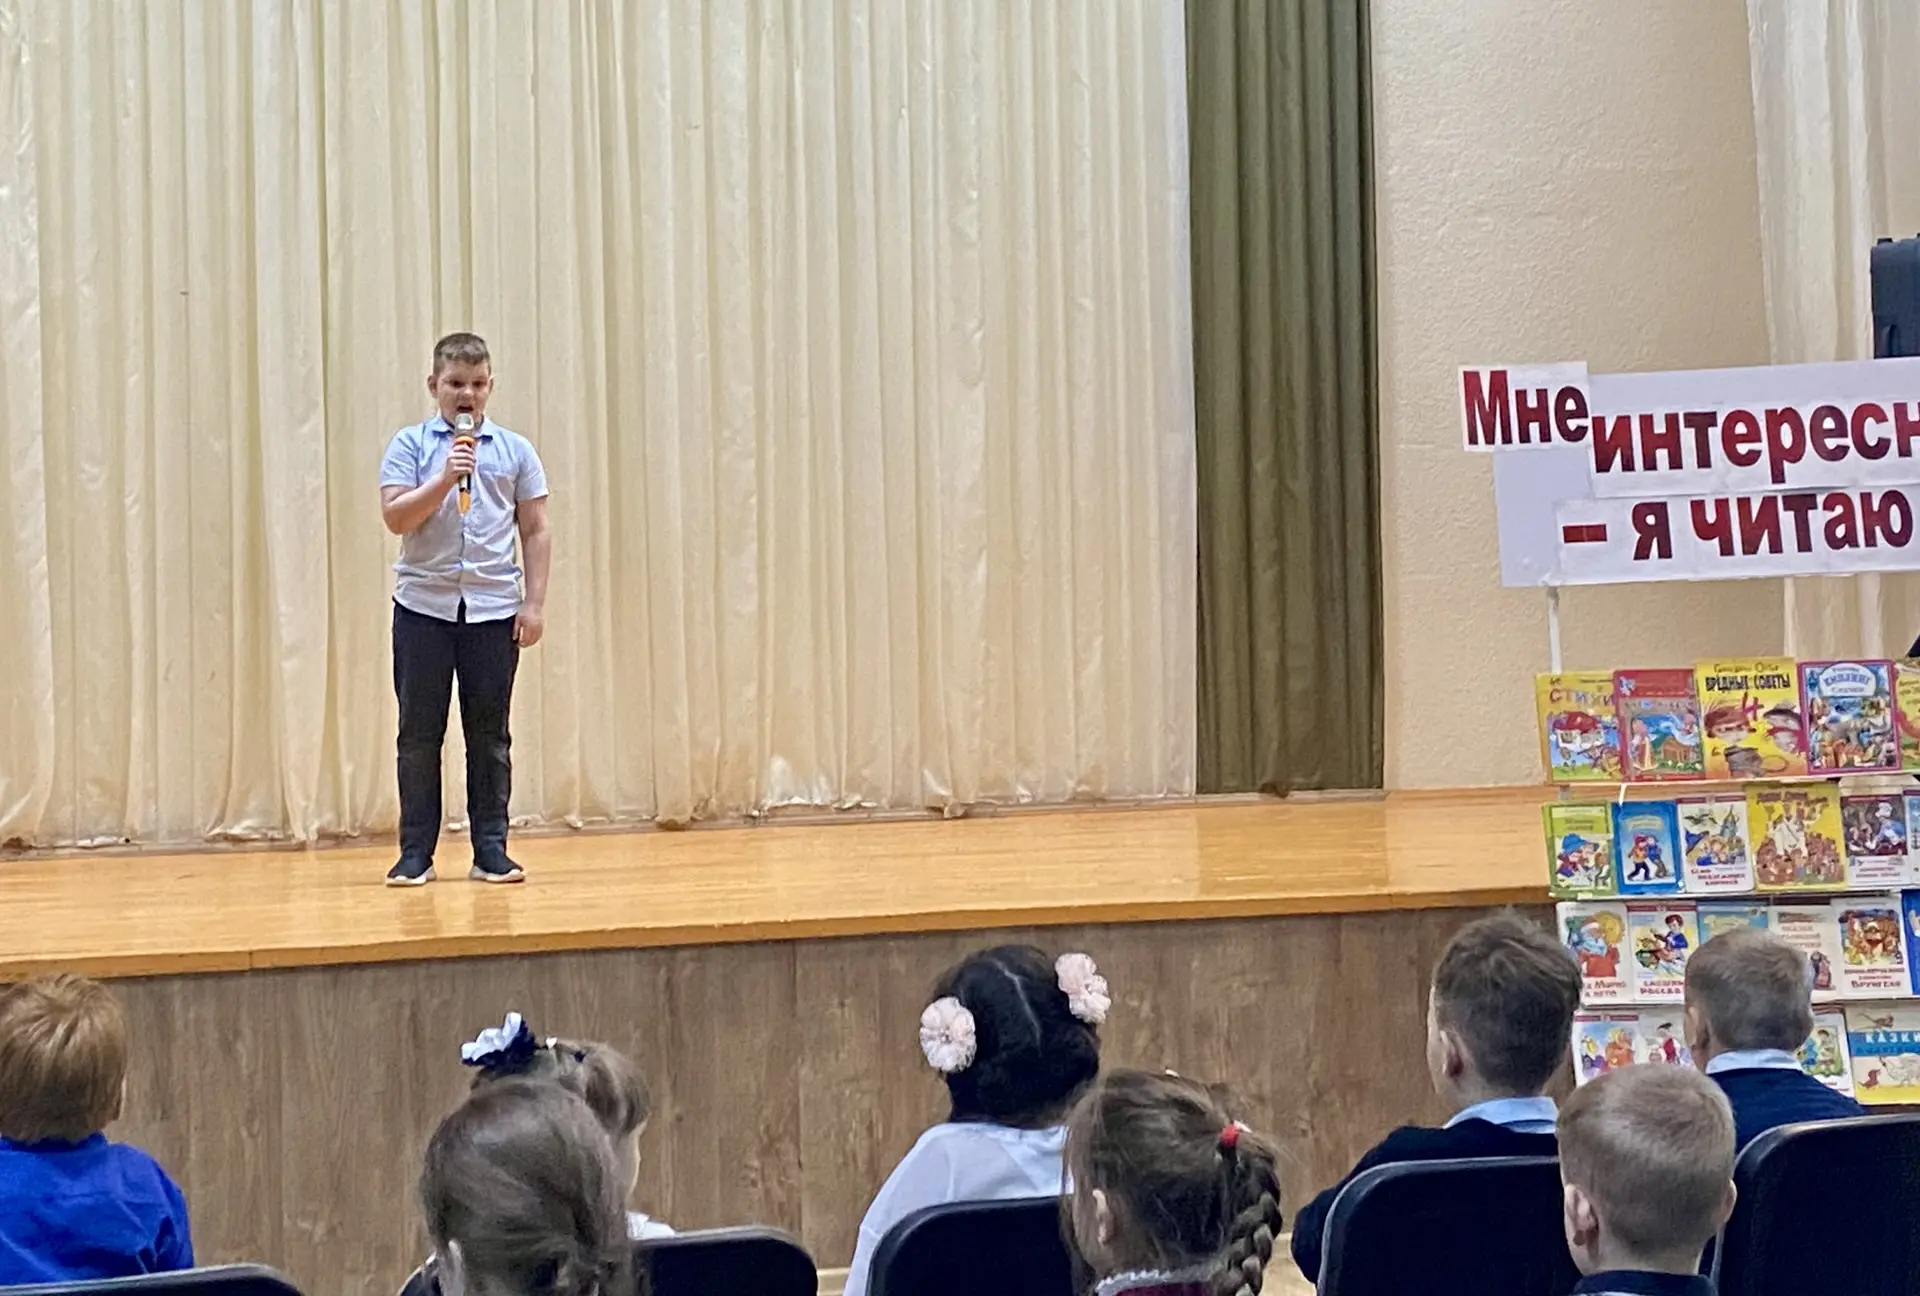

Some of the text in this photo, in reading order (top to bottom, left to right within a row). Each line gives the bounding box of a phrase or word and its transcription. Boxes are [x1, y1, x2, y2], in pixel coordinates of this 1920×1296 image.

[1462, 369, 1920, 484] Мне интересн
[1632, 501, 1673, 560] я
[1690, 489, 1913, 557] читаю
